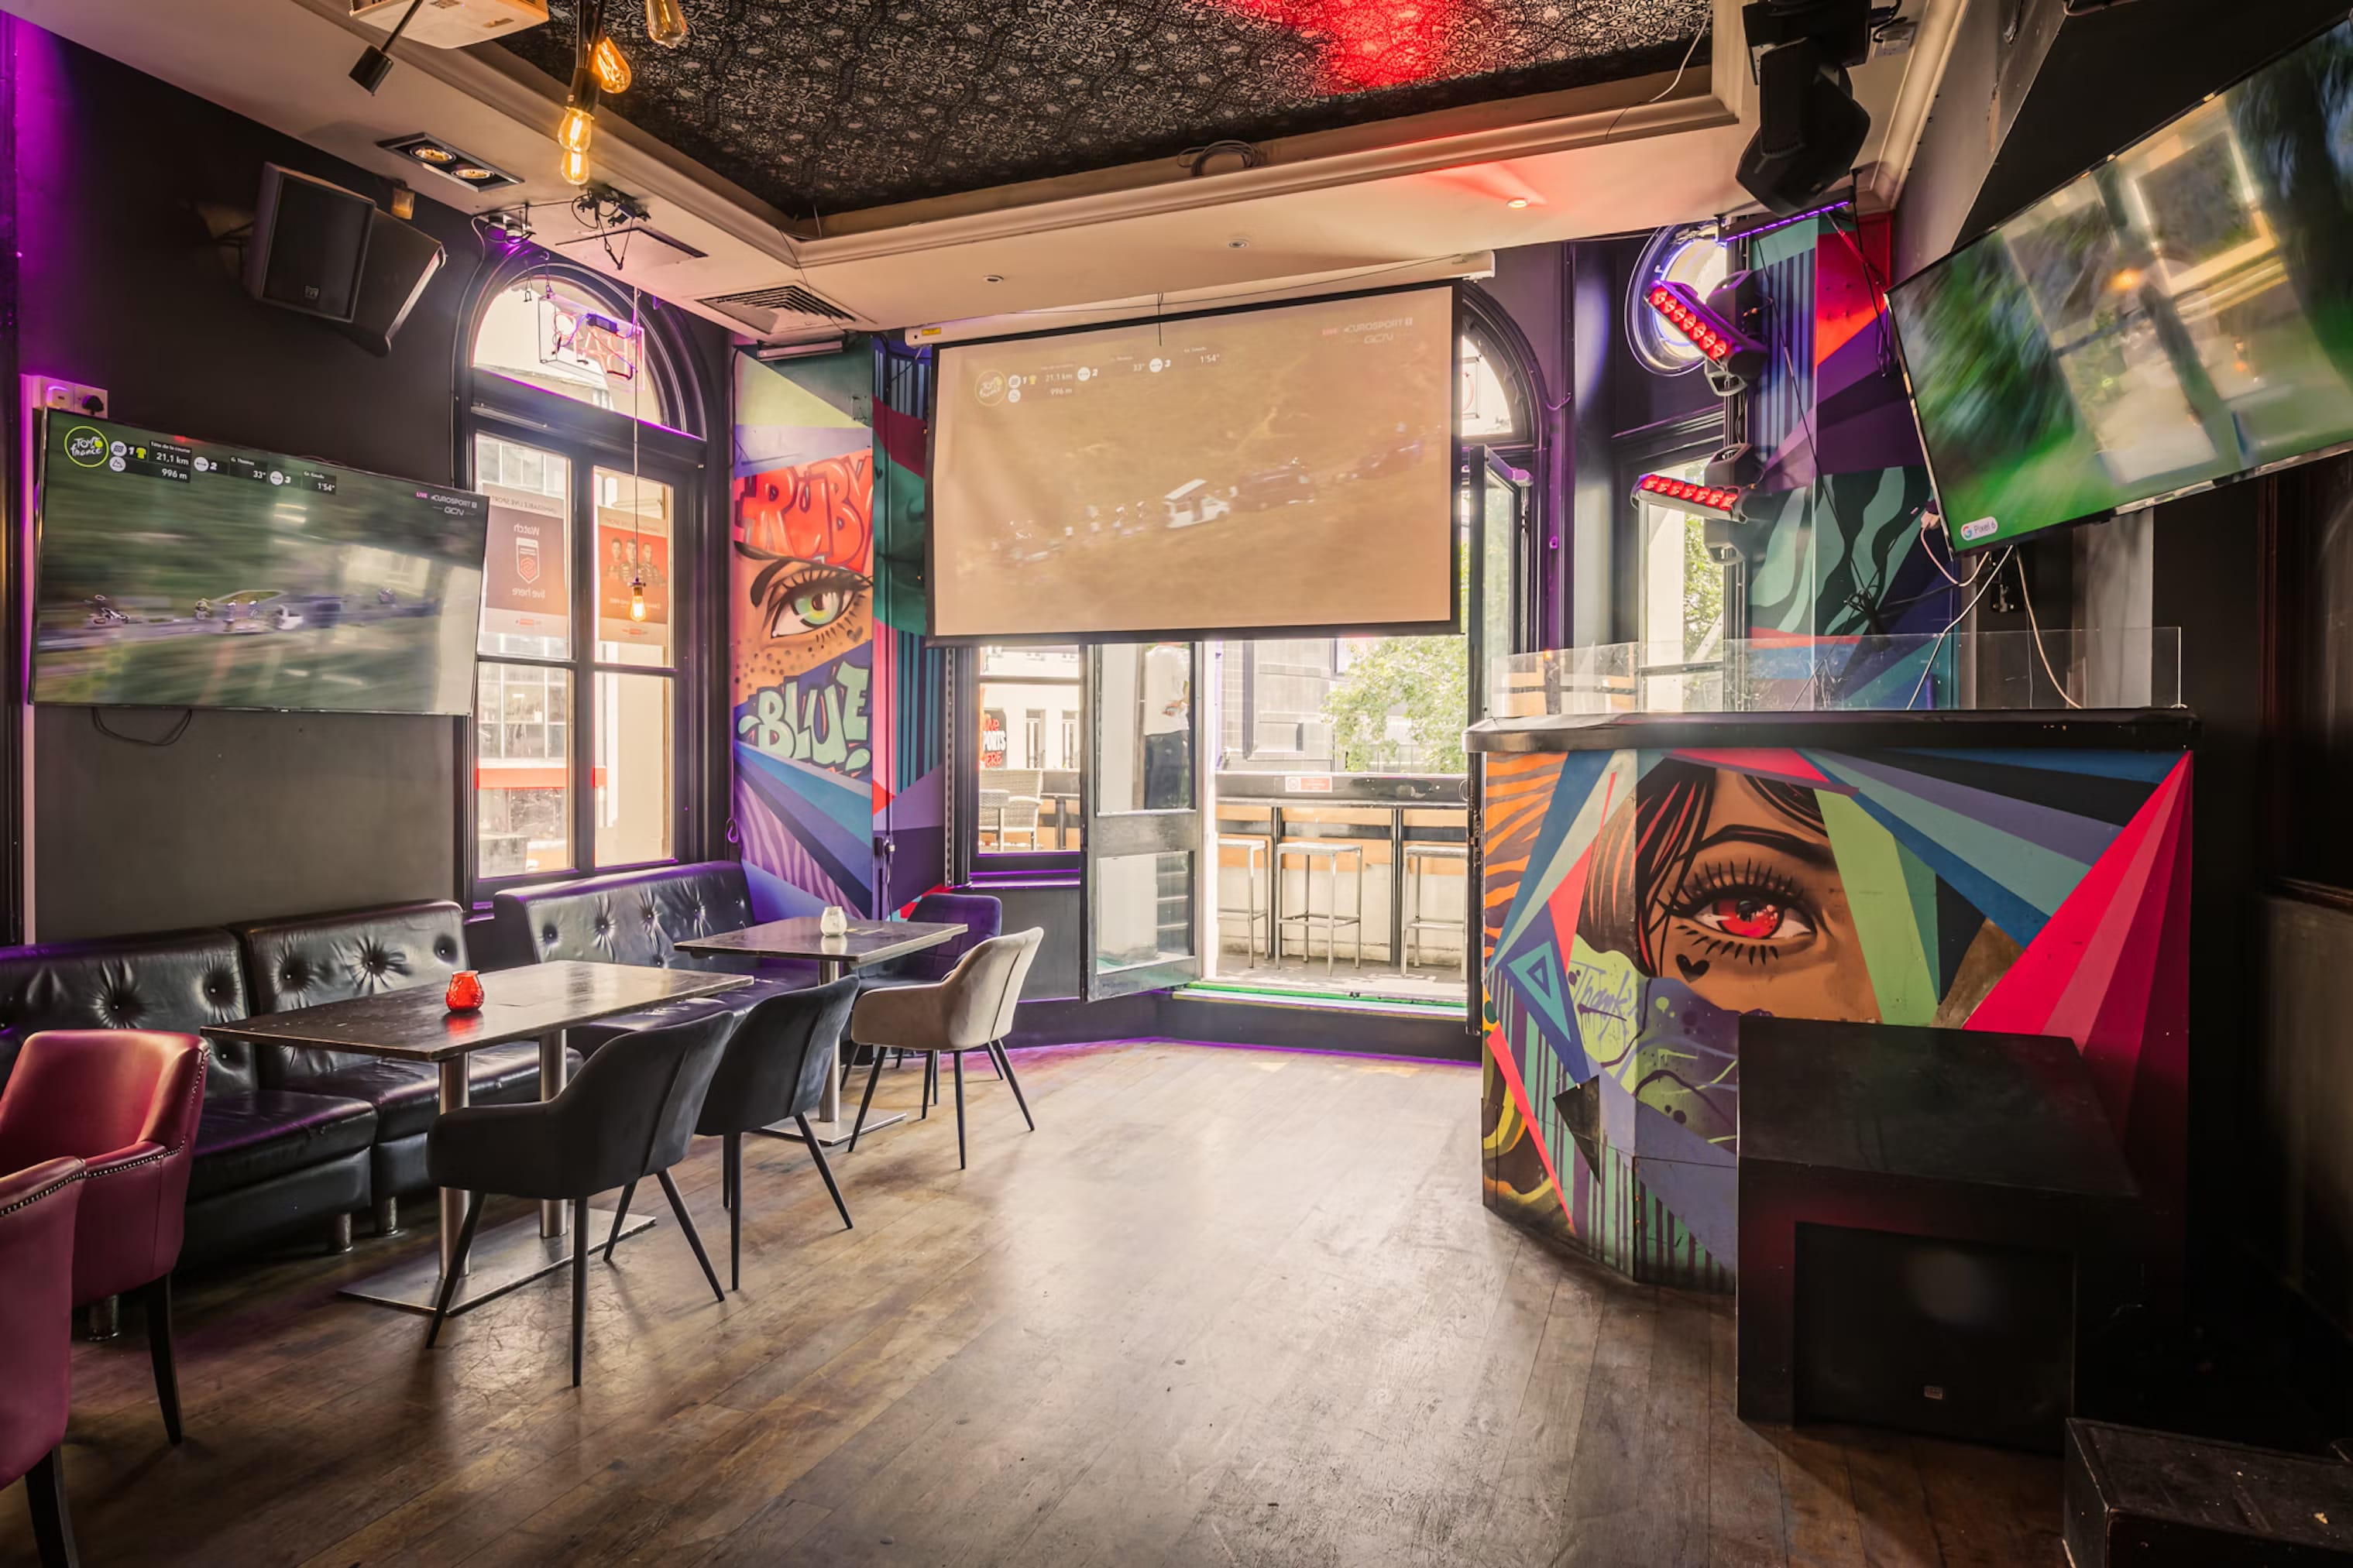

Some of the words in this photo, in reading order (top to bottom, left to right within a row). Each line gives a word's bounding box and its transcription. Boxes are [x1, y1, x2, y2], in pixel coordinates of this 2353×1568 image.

[1092, 369, 1098, 377] 2
[129, 447, 135, 455] 1
[176, 456, 190, 465] km
[210, 462, 218, 471] 2
[161, 468, 177, 479] 996
[284, 475, 291, 484] 3
[742, 455, 873, 573] RUBY
[741, 660, 869, 765] BLUE
